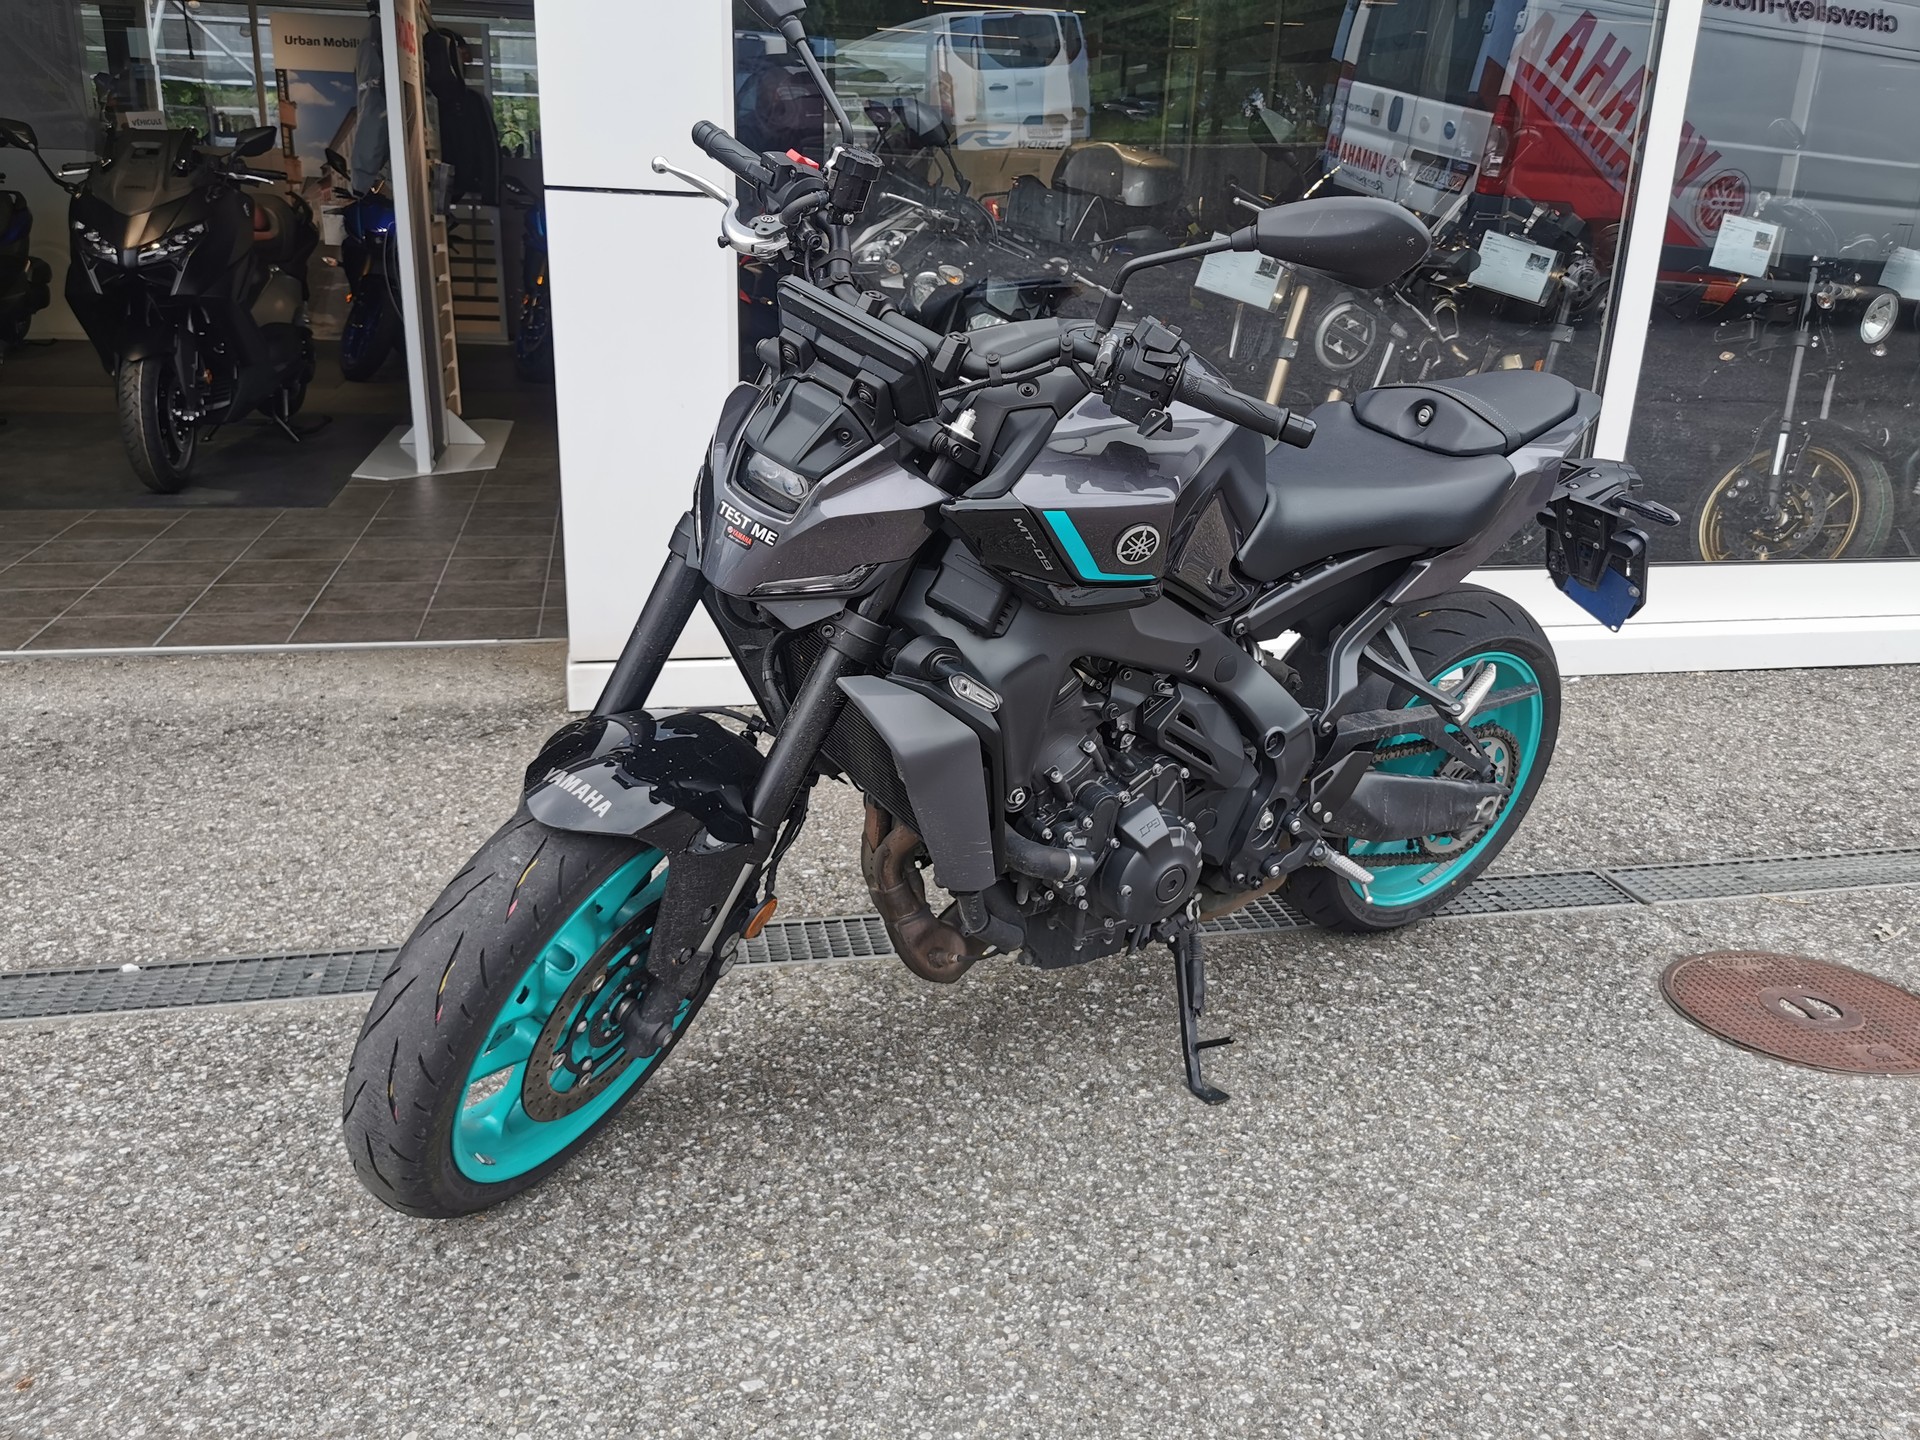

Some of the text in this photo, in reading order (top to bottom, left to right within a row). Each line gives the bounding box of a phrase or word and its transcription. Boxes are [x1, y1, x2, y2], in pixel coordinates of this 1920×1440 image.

[284, 35, 321, 47] Urban
[1017, 140, 1066, 150] WORLD
[719, 500, 752, 530] TEST
[750, 522, 779, 547] ME
[1012, 518, 1054, 571] MT-09
[542, 766, 613, 819] YAMAHA
